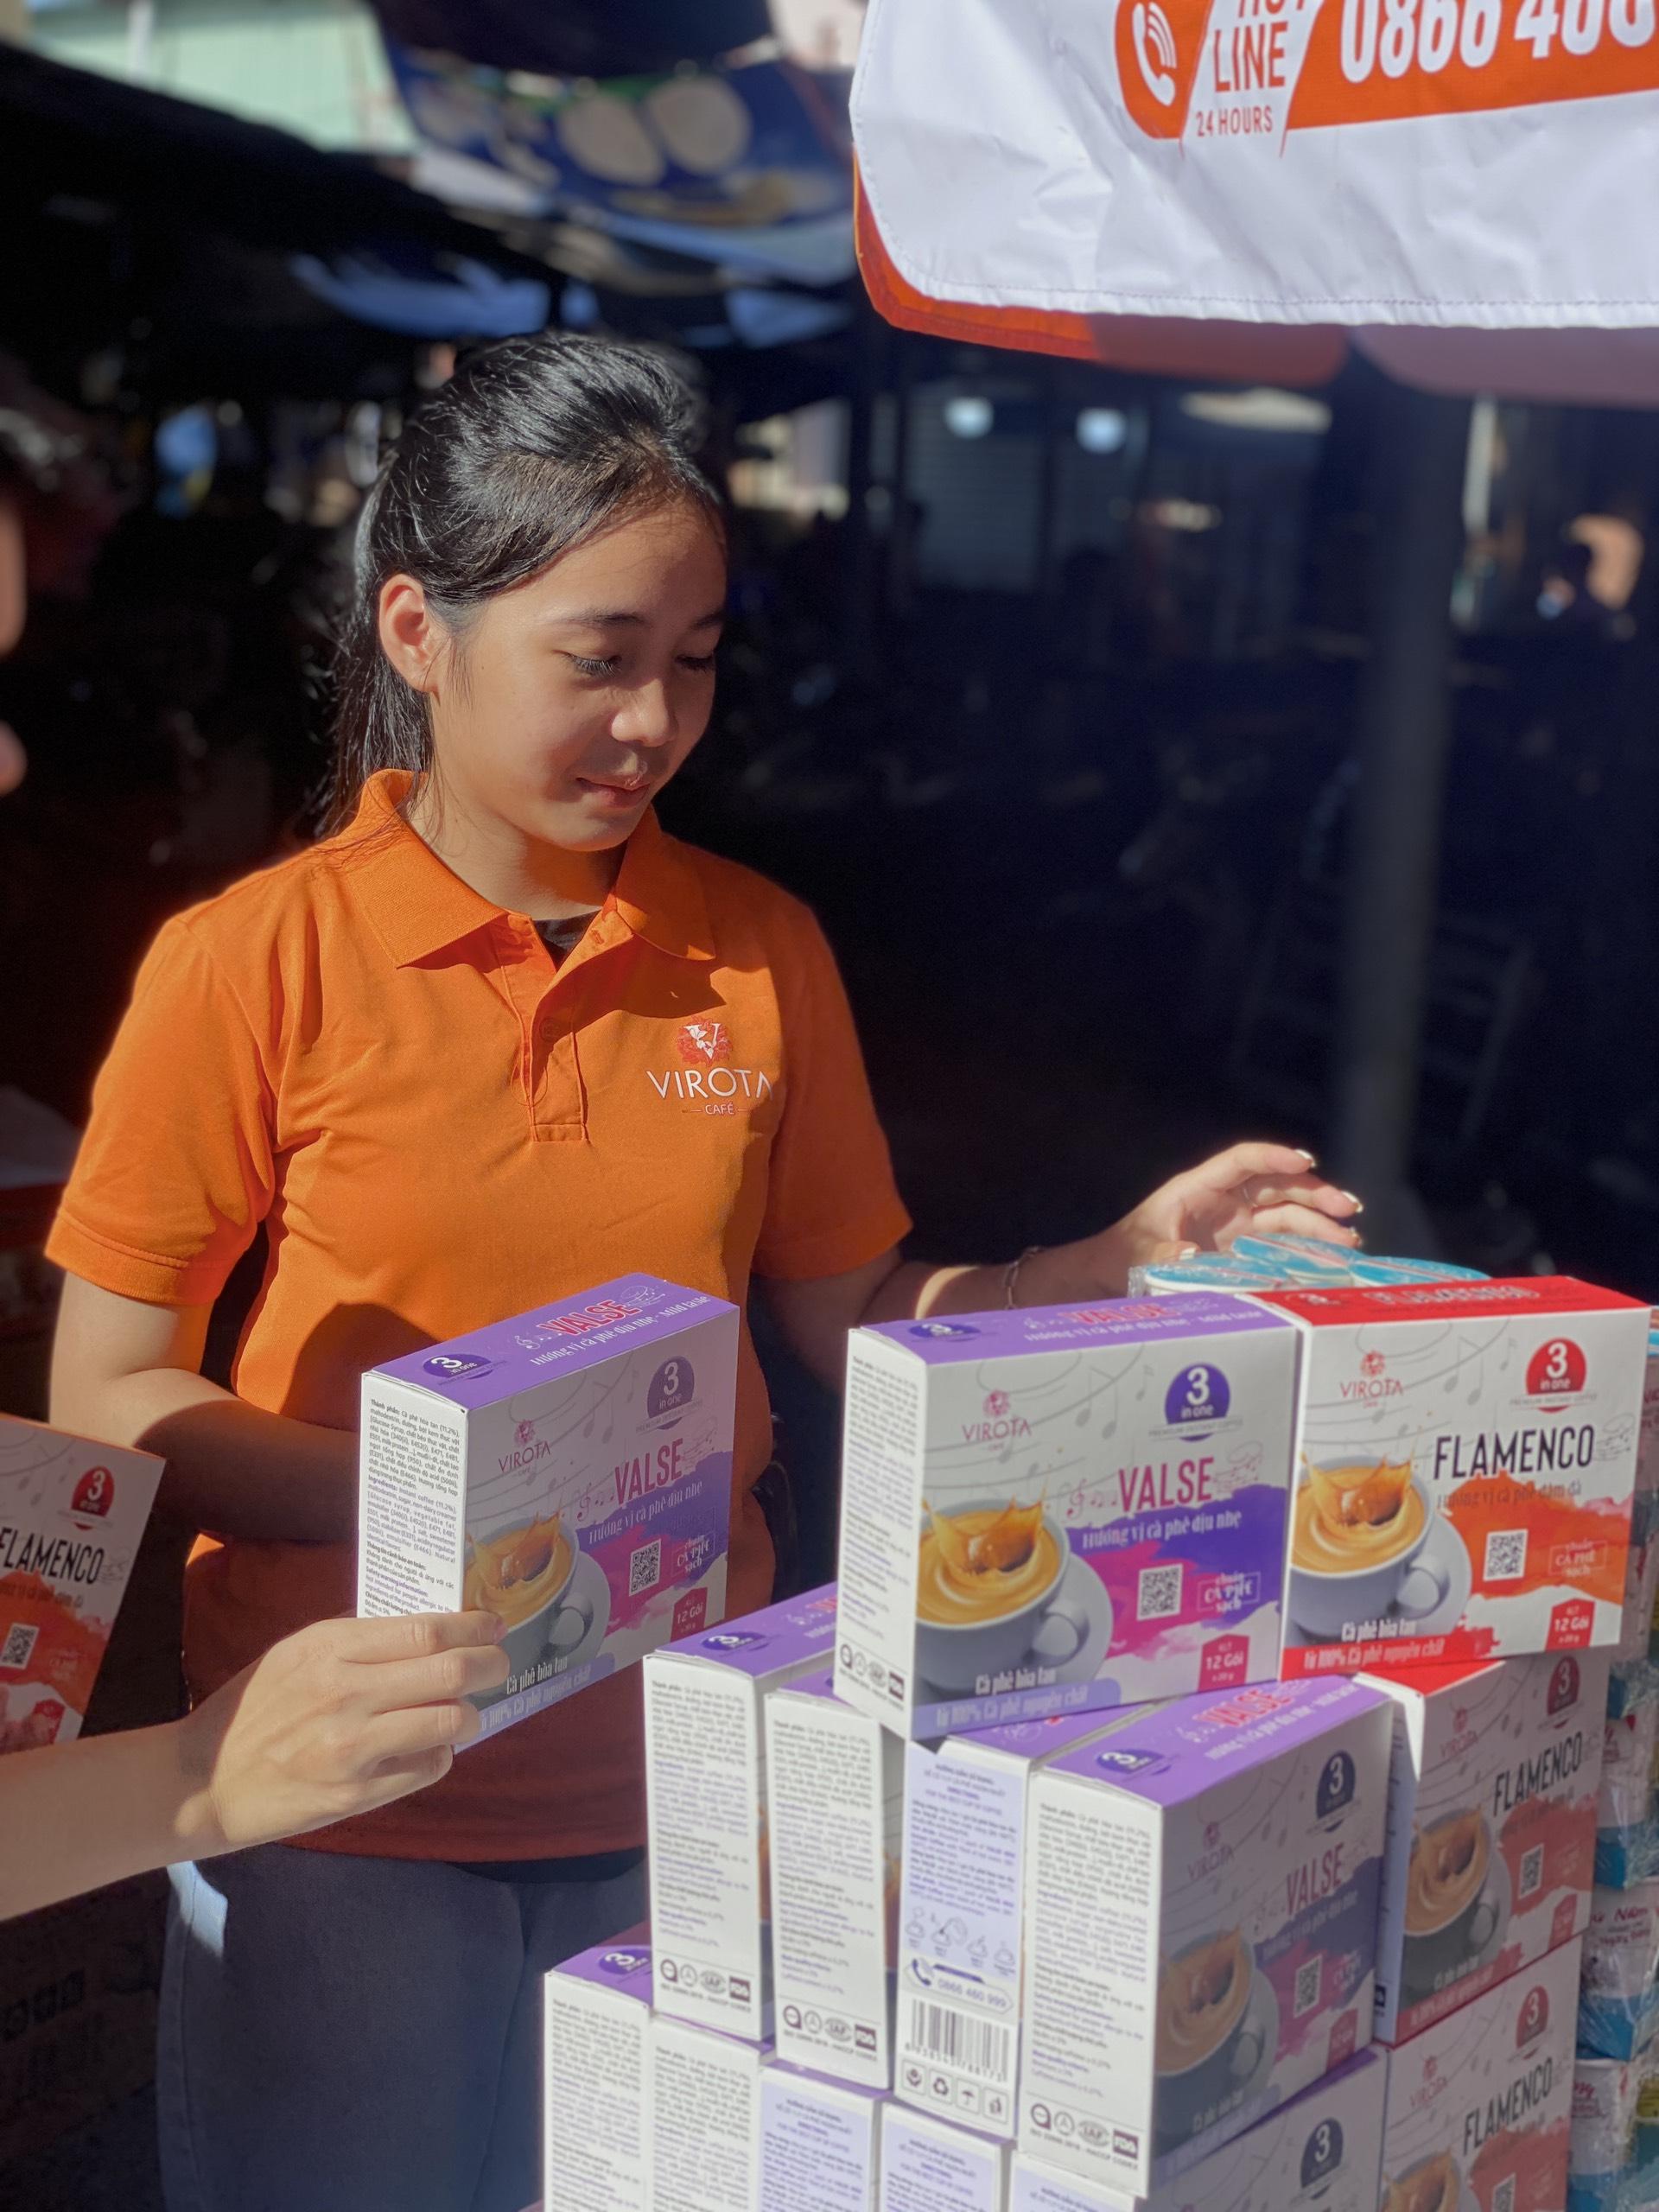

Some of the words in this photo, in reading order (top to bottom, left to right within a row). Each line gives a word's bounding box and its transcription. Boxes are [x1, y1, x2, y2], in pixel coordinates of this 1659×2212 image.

[1214, 21, 1287, 92] LINE
[1196, 111, 1213, 137] 24
[1218, 105, 1273, 135] HOURS
[646, 1067, 773, 1100] VIROTA
[705, 1102, 734, 1115] CAFÉ
[537, 1300, 642, 1336] VALSE
[681, 1295, 711, 1310] taste
[1058, 1303, 1178, 1325] VALSE
[431, 1357, 462, 1368] 3
[1546, 1342, 1567, 1378] 3
[664, 1362, 679, 1395] 3
[1186, 1367, 1211, 1406] 3
[1339, 1378, 1404, 1398] VIROTA
[1551, 1376, 1571, 1390] one
[659, 1398, 668, 1409] in
[668, 1394, 683, 1407] one
[1180, 1405, 1192, 1419] in
[1192, 1403, 1214, 1418] one
[961, 1417, 1032, 1442] VIROTA
[498, 1440, 551, 1472] VIROTA
[1433, 1425, 1594, 1479] FLAMENCO
[87, 1470, 105, 1502] 3
[614, 1438, 683, 1504] VALSE
[1119, 1456, 1214, 1513] VALSE
[1083, 1527, 1128, 1549] Hương
[1131, 1523, 1145, 1542] vị
[1146, 1518, 1161, 1538] cà
[1164, 1515, 1191, 1541] phê
[1192, 1512, 1214, 1534] dịu
[0, 1527, 105, 1585] FLAMENCO
[677, 1611, 688, 1624] 12
[690, 1603, 704, 1619] Gói
[1341, 1621, 1356, 1642] Cà
[1357, 1618, 1377, 1643] phê
[1399, 1617, 1417, 1637] tan
[1554, 1618, 1568, 1631] 12
[1571, 1616, 1590, 1630] Gói
[506, 1677, 518, 1694] Cà
[519, 1667, 536, 1692] phê
[537, 1662, 554, 1681] hòa
[554, 1656, 568, 1673] tan
[1205, 1657, 1222, 1670] 12
[1224, 1652, 1244, 1668] Gói
[976, 1673, 991, 1694] Cà
[991, 1669, 1014, 1695] phê
[1014, 1667, 1036, 1688] hòa
[1038, 1666, 1056, 1685] tan
[1558, 1662, 1573, 1694] 3
[1192, 1688, 1295, 1727] VALSE
[1328, 1756, 1344, 1796] 3
[1493, 1730, 1583, 1818] FLAMENCO
[1285, 1842, 1345, 1916] VALSE
[1527, 1992, 1540, 2026] 3
[1463, 2056, 1554, 2158] FLAMENCO
[1314, 2122, 1332, 2164] 3
